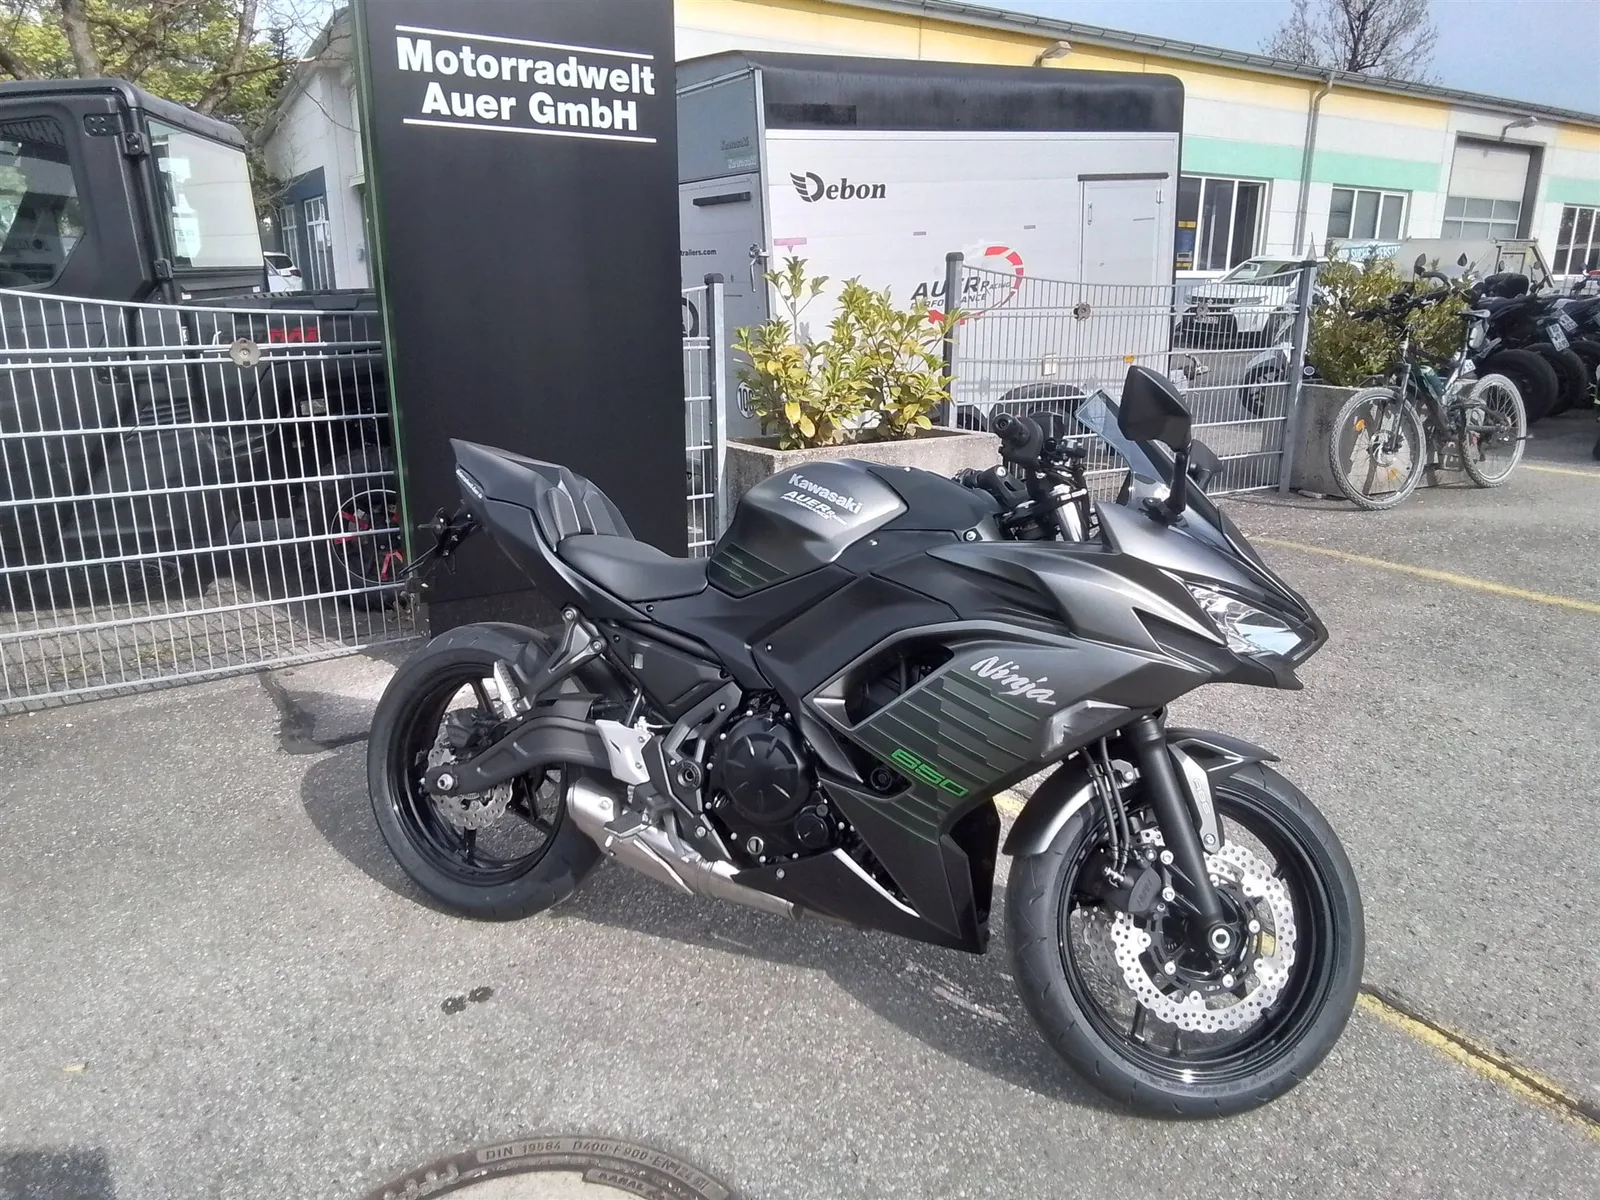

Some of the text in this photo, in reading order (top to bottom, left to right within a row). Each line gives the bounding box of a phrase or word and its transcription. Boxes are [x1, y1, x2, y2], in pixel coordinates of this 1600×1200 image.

[396, 36, 655, 96] Motorradwelt
[421, 81, 638, 131] Auer GmbH
[790, 171, 887, 203] Debon
[910, 276, 981, 301] AUR
[783, 490, 832, 513] AUER
[787, 473, 863, 514] Kawasaki
[969, 655, 1056, 706] Ninja
[891, 748, 969, 798] 650
[486, 1146, 514, 1160] DIN
[522, 1141, 561, 1154] 19584
